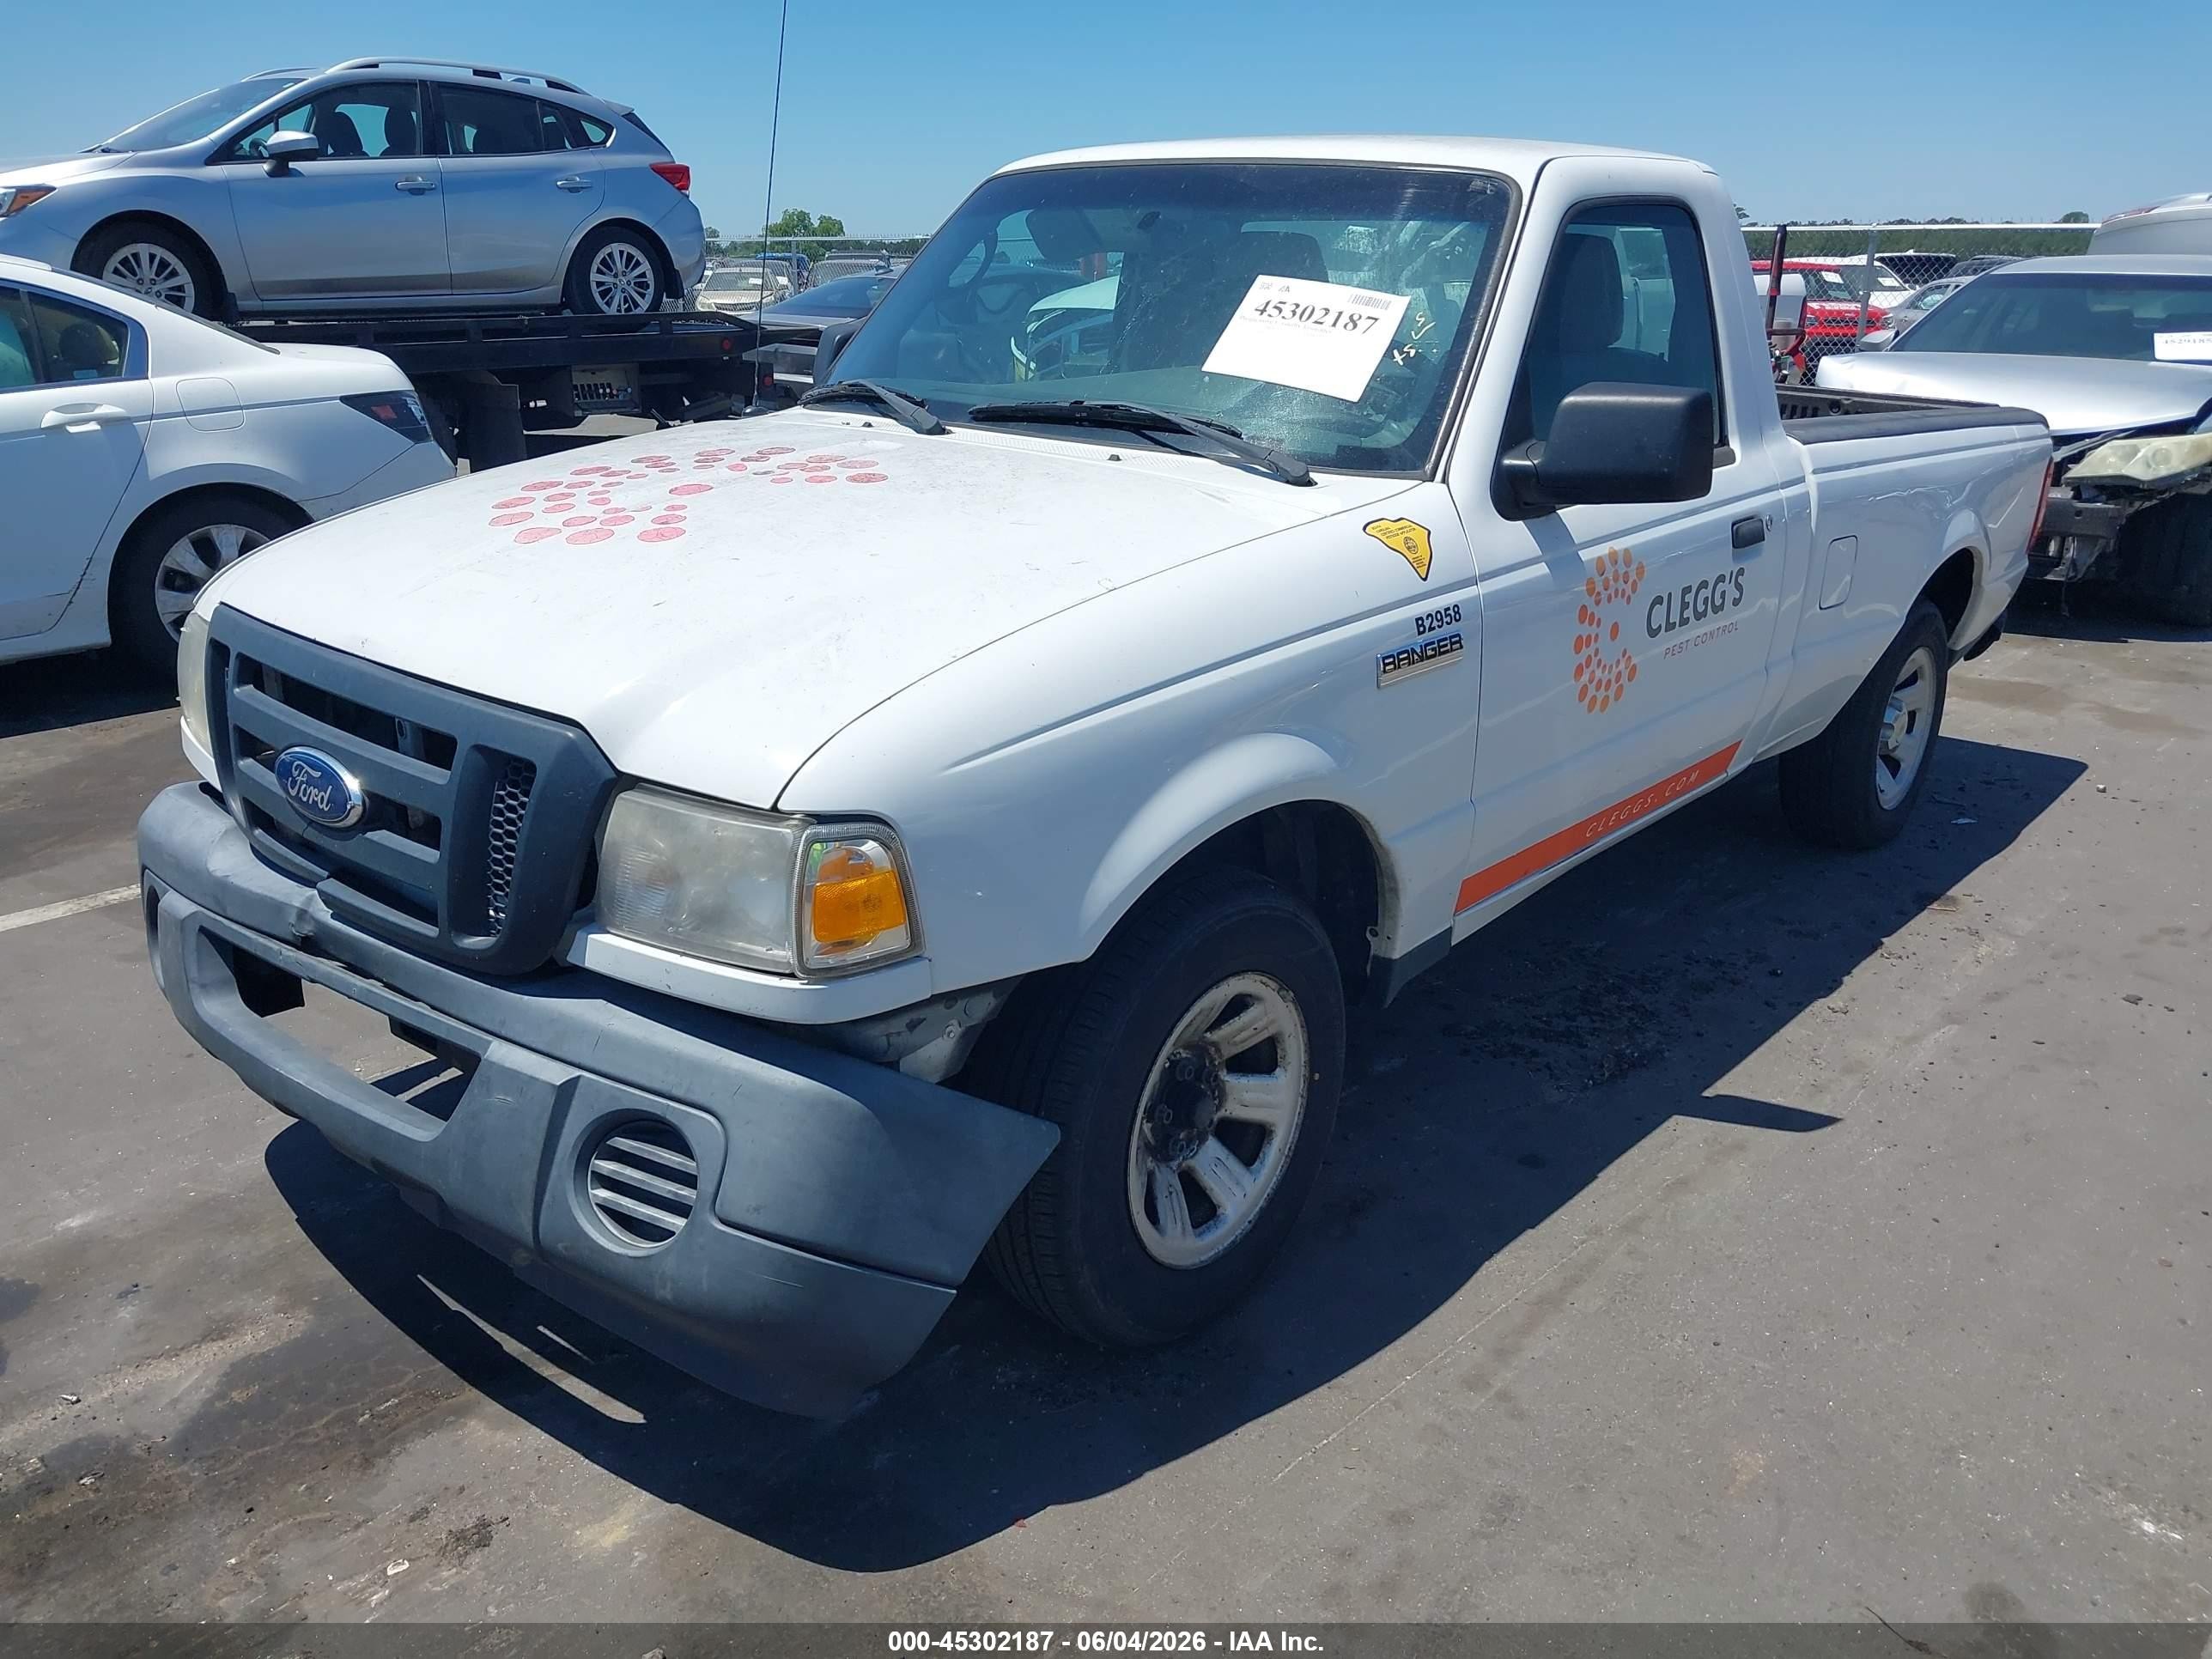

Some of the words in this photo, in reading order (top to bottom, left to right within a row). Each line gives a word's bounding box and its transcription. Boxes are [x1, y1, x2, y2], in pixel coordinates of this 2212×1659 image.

[1254, 299, 1381, 335] 45302187
[1414, 604, 1462, 636] B2958
[1646, 567, 1746, 639] CLEGG'S
[1381, 632, 1464, 674] RANGER
[1663, 641, 1692, 659] PEST
[1693, 621, 1740, 647] CONTROL
[288, 761, 333, 811] Ford
